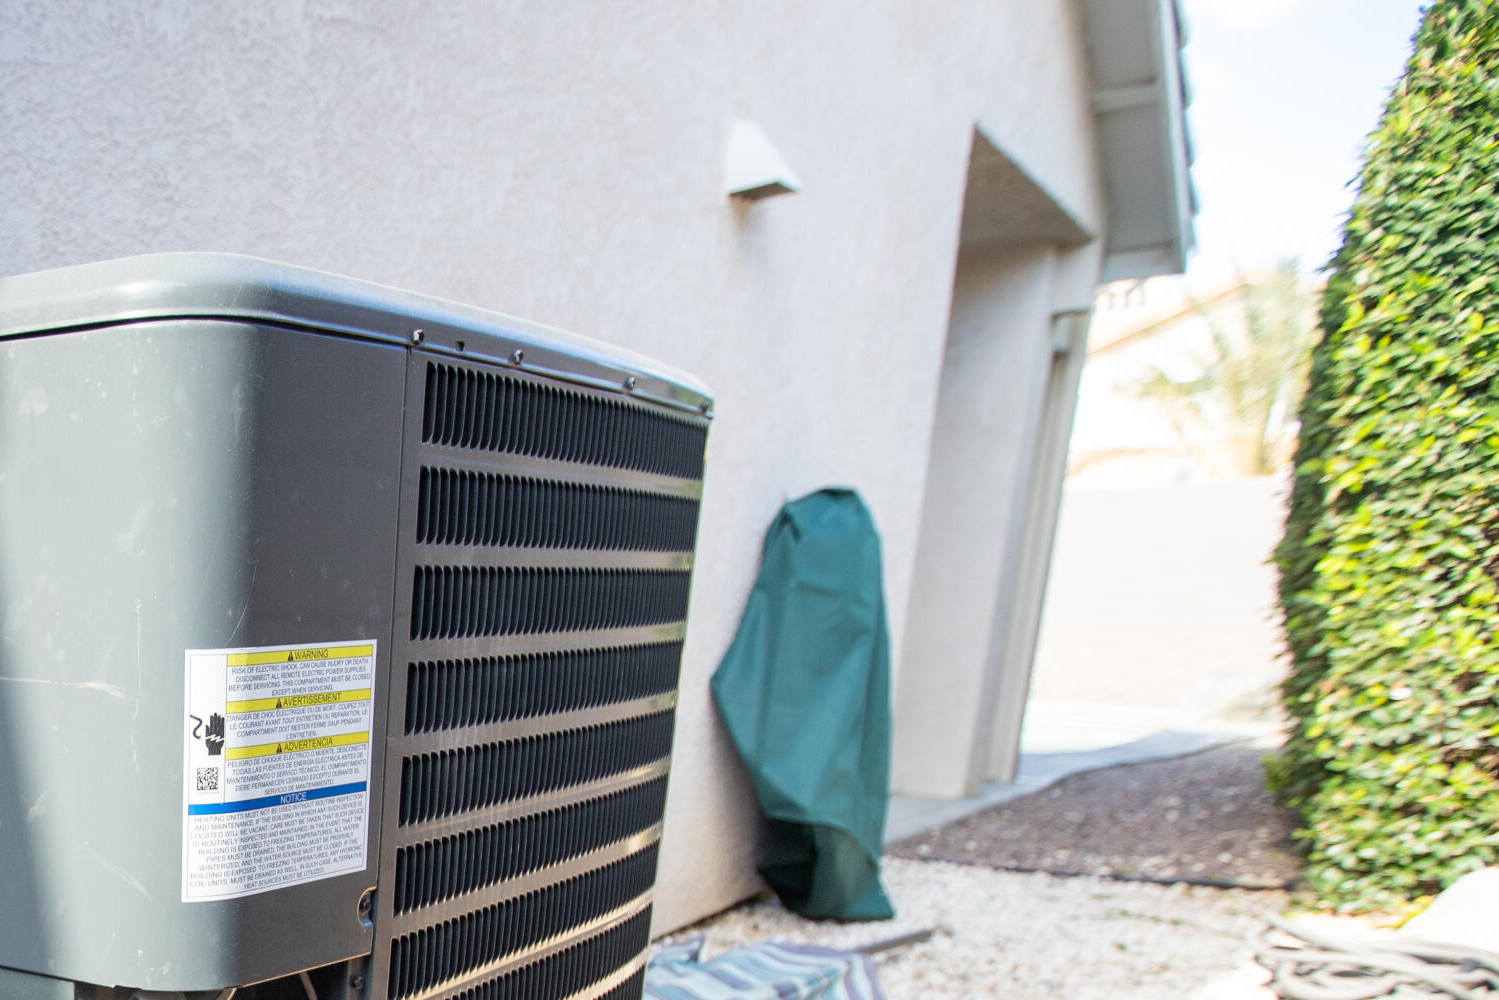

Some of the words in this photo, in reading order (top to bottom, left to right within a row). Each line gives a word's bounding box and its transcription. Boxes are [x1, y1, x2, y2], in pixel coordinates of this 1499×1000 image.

[295, 649, 329, 660] WARNING
[256, 665, 280, 673] ELECTRIC
[311, 661, 326, 669] CAUSE
[236, 674, 270, 683] DISCONNECT
[281, 671, 300, 679] REMOTE
[302, 669, 325, 678] ELECTRIC
[345, 666, 366, 674] SUPPLIES
[228, 683, 253, 692] BEFORE
[294, 677, 330, 686] COMPARTMENT
[352, 673, 371, 681] CLOSED
[272, 688, 291, 696] EXCEPT
[283, 693, 342, 707] AVERTISSEMENT
[239, 720, 265, 729] COURANT
[265, 718, 281, 726] AVANT
[296, 714, 322, 723] ENTRETIEN
[261, 711, 276, 719] CHOC
[237, 727, 277, 737] COMPARTIMENT
[279, 725, 290, 733] DOIT
[291, 723, 310, 732] RESTER
[341, 717, 362, 726] PENDANT
[284, 737, 332, 752] ADVERTENCIA
[228, 759, 253, 768] PELIGRO
[261, 756, 282, 764] CHOQUE
[232, 767, 251, 776] TODAS
[263, 762, 285, 772] FUENTES
[286, 761, 292, 769] DE
[236, 784, 250, 792] DEBE
[251, 779, 285, 790] PERMANECER
[286, 775, 309, 785] CERRADO
[310, 771, 331, 781] EXCEPTO
[332, 768, 352, 777] DURANTE
[281, 792, 307, 805] NOTICE
[245, 811, 259, 819] MUST
[260, 809, 270, 817] NOT
[271, 807, 278, 815] BE
[279, 805, 292, 814] USED
[262, 816, 270, 824] THE
[239, 832, 267, 844] INSPECTED
[269, 830, 279, 839] AND
[240, 828, 248, 836] BE
[238, 841, 263, 852] EXPOSED
[263, 840, 270, 848] TO
[271, 835, 294, 846] FREEZING
[228, 852, 244, 861] MUST
[242, 858, 252, 867] AND
[264, 853, 281, 863] WATER
[232, 866, 256, 876] EXPOSED
[231, 875, 246, 884] MUST
[247, 873, 254, 882] BE
